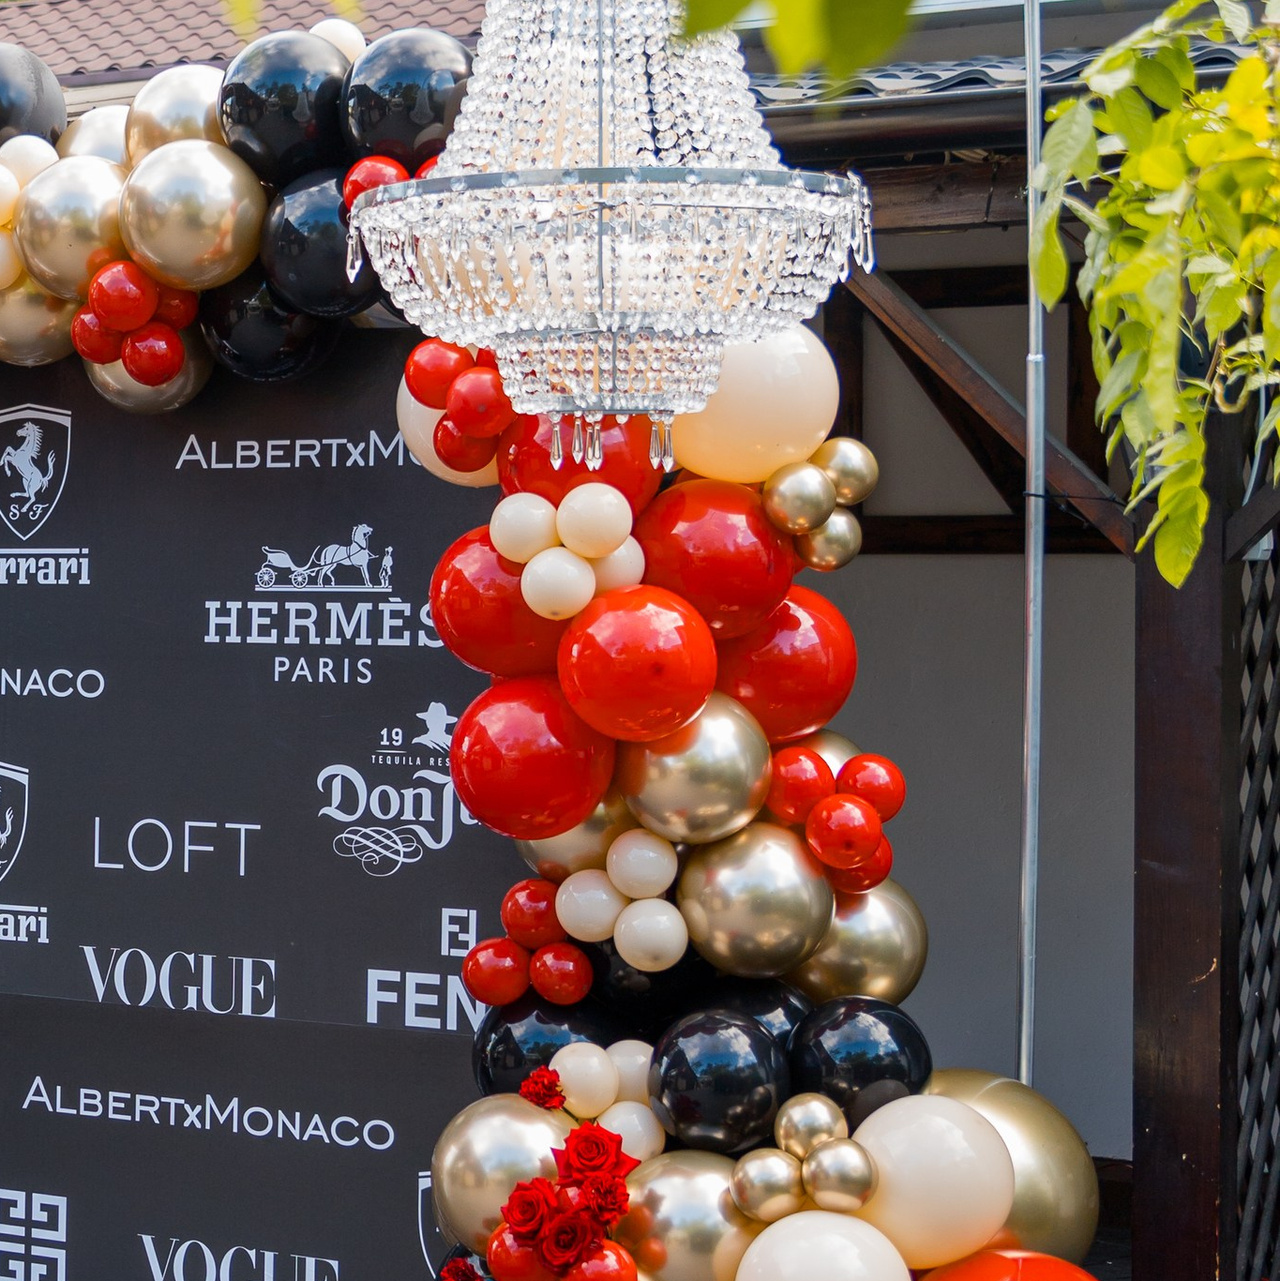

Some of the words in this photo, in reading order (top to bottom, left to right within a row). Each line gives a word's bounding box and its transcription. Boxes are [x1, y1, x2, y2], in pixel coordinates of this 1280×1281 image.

[275, 657, 371, 683] PARIS
[379, 727, 404, 747] 19
[371, 754, 421, 766] TEQUILA
[95, 817, 261, 876] LOFT
[79, 946, 275, 1017] VOGUE
[22, 1076, 394, 1149] ALBERTxMONACO
